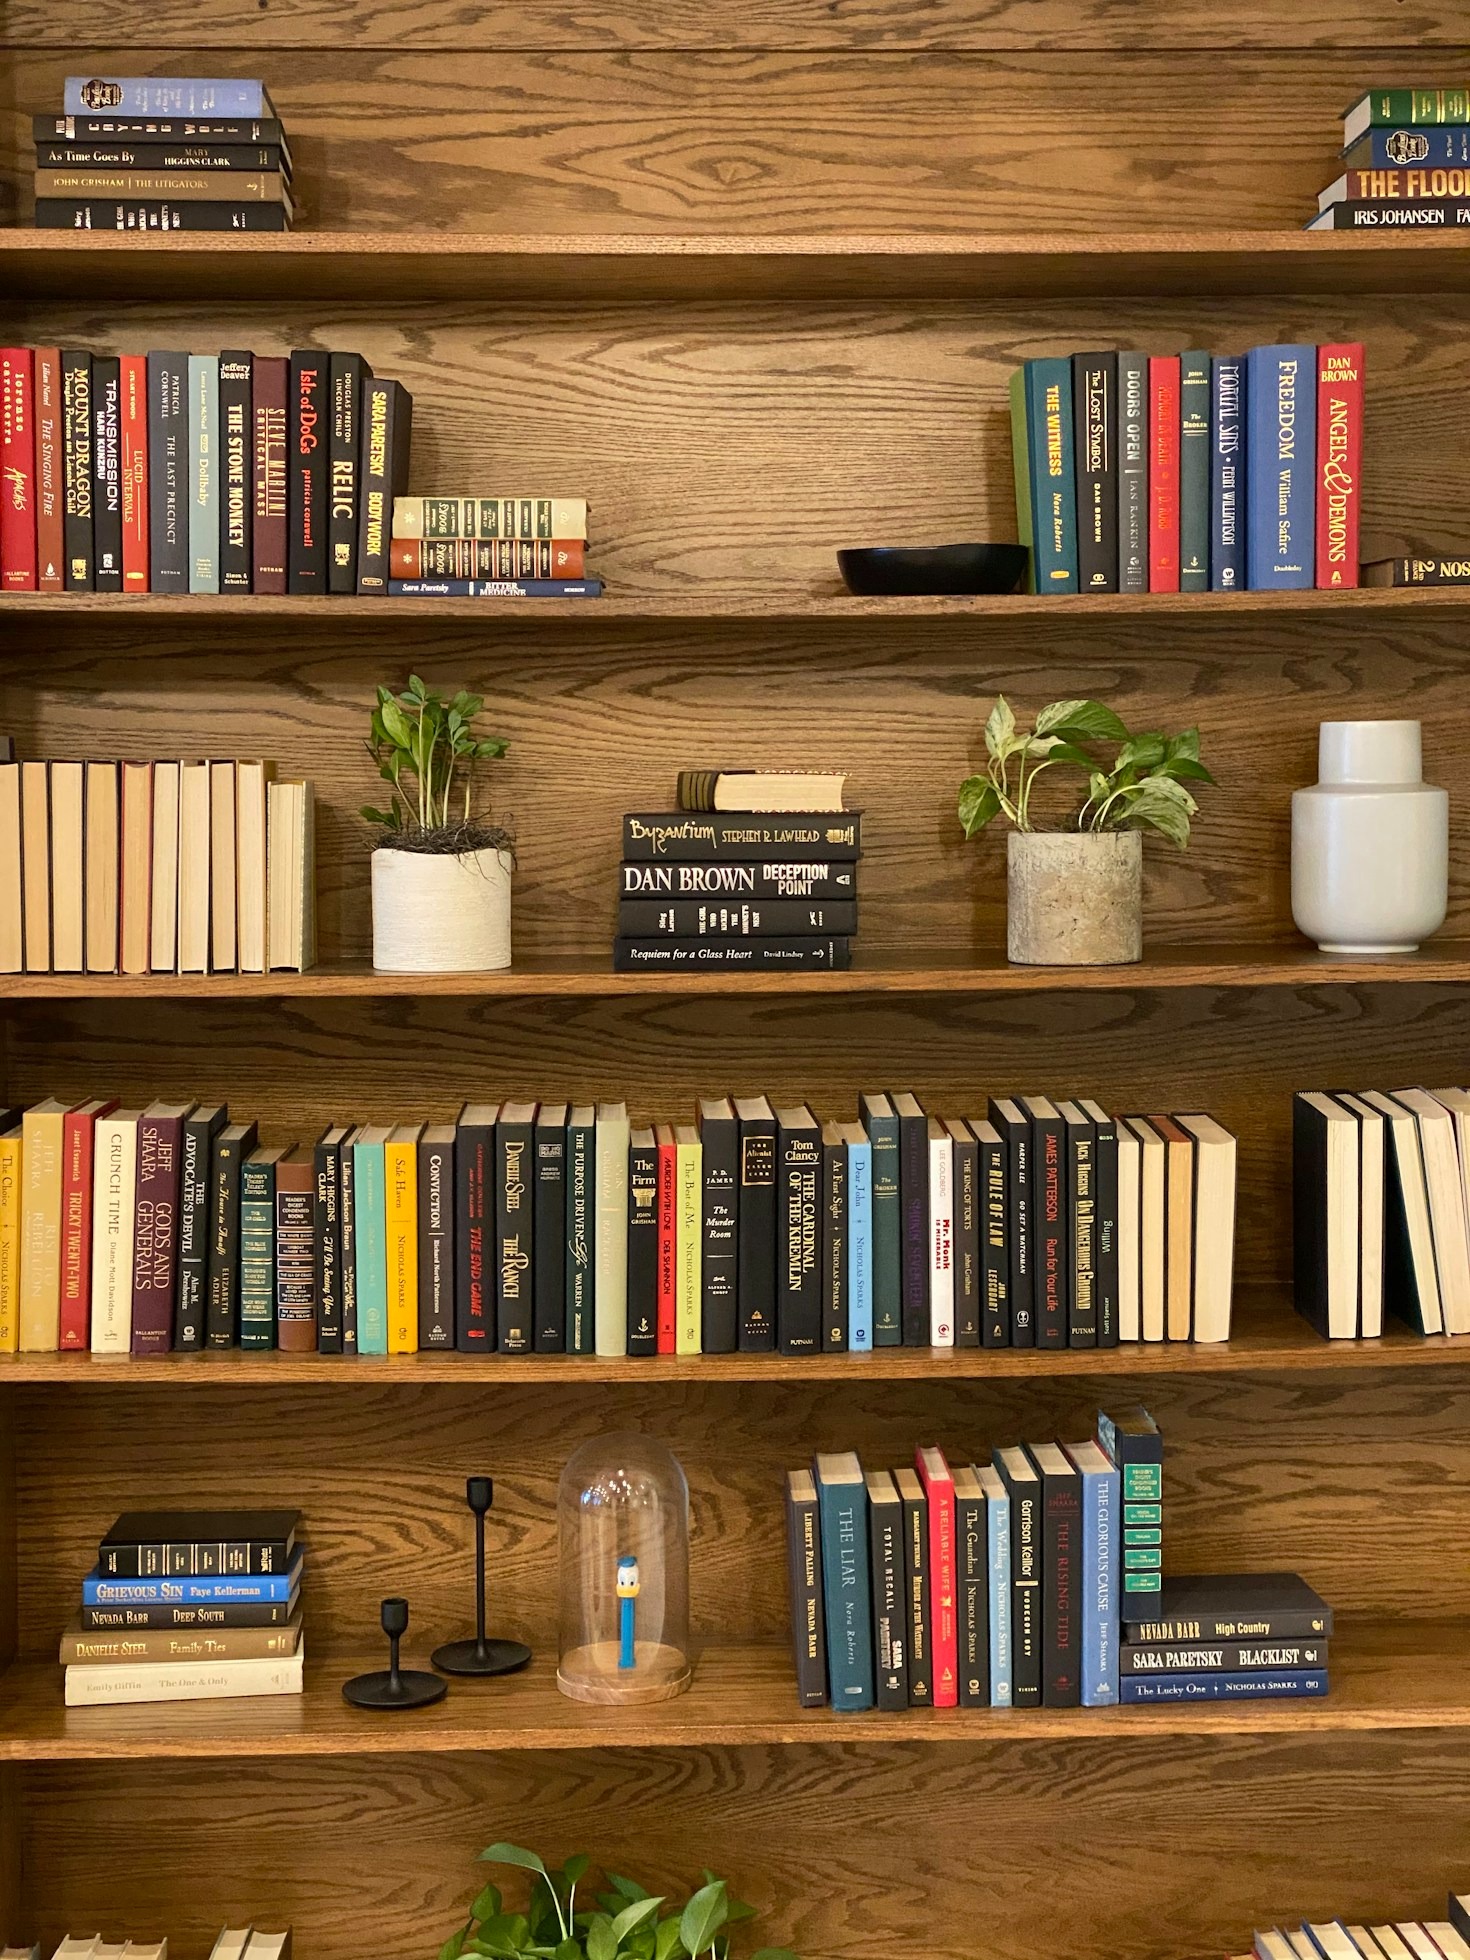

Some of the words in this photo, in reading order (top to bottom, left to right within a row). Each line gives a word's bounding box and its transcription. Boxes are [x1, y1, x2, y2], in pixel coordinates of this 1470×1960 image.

[49, 152, 62, 160] As
[65, 152, 90, 161] Time
[93, 152, 119, 162] Goes
[122, 152, 135, 163] By
[165, 158, 200, 166] HIGGINS
[201, 158, 230, 166] CLARK
[156, 180, 208, 188] LITIGATORS
[1357, 170, 1399, 198] THE
[1355, 211, 1378, 224] IRIS
[1380, 210, 1444, 224] JOHANSEN
[1321, 370, 1357, 382] BROWN
[1328, 357, 1350, 368] DAN
[300, 370, 317, 394] Isle
[1092, 371, 1100, 386] The
[1219, 366, 1239, 421] MORTAL
[74, 368, 89, 436] MOUNT
[161, 371, 169, 418] CORNWELL
[300, 397, 314, 410] of
[371, 392, 386, 420] SARA
[1047, 385, 1059, 411] THE
[1091, 389, 1103, 420] LOST
[1127, 371, 1140, 418] DOORS
[1279, 361, 1297, 459] FREEDOM
[42, 420, 53, 439] THE
[228, 405, 242, 432] THE
[269, 409, 286, 447] STEVE
[1330, 398, 1347, 462] ANGELS
[106, 380, 117, 510] TRANSMISSION
[167, 436, 175, 458] THE
[257, 408, 265, 470] CRITICAL
[369, 423, 385, 476] PARETSKY
[1047, 414, 1062, 476] WITNESS
[1091, 424, 1103, 472] SYMBOL
[1127, 424, 1140, 460] OPEN
[1219, 424, 1239, 453] SINS
[42, 443, 54, 488] SINGING
[133, 450, 143, 482] LUCID
[167, 462, 175, 487] LAST
[228, 438, 243, 482] STONE
[75, 441, 90, 518] DRAGON
[197, 459, 209, 506] Dollbaby
[269, 460, 286, 516] MARTINI
[333, 461, 353, 518] RELIC
[1279, 470, 1291, 515] William
[43, 492, 54, 516] FIRE
[124, 469, 133, 522] INTERVALS
[257, 481, 265, 516] MASS
[167, 492, 175, 544] PRECINCT
[229, 487, 243, 547] MONKEY
[1329, 495, 1347, 562] DEMONS
[1279, 521, 1290, 554] Safire
[630, 820, 717, 854] Byzantium
[722, 831, 760, 842] STEPHEN
[764, 831, 771, 842] R.
[774, 831, 819, 842] LAWHEAD
[625, 868, 672, 890] DAN
[679, 868, 755, 890] BROWN
[763, 865, 828, 880] DECEPTION
[778, 880, 813, 895] POINT
[631, 950, 670, 960] Requiem
[673, 950, 687, 959] for
[699, 949, 723, 958] Glass
[726, 950, 752, 958] Heart
[142, 1127, 156, 1182] SHAARA
[158, 1139, 172, 1171] JEFF
[576, 1133, 584, 1149] THE
[785, 1151, 819, 1161] Clancy
[791, 1140, 813, 1150] Tom
[1046, 1134, 1057, 1164] JAMES
[110, 1134, 122, 1193] CRUNCH
[185, 1133, 196, 1212] ADVOCATE'S
[395, 1159, 405, 1176] Safe
[505, 1141, 524, 1181] DANIELLE
[575, 1153, 584, 1196] PURPOSE
[855, 1161, 865, 1182] Dear
[991, 1153, 1000, 1166] THE
[195, 1182, 205, 1204] THE
[396, 1181, 406, 1208] Haven
[430, 1155, 442, 1228] CONVICTION
[789, 1172, 801, 1189] OF
[803, 1172, 815, 1200] THE
[989, 1170, 1003, 1199] RULE
[1046, 1168, 1057, 1221] PATTERSON
[69, 1192, 82, 1227] TRICKY
[327, 1186, 335, 1222] HIGGINS
[505, 1182, 525, 1212] STEEL
[789, 1194, 801, 1226] THE
[855, 1186, 865, 1207] John
[989, 1203, 1003, 1218] OF
[108, 1200, 120, 1234] TIME
[155, 1203, 171, 1247] GODS
[575, 1200, 585, 1237] DRIVEN
[136, 1200, 153, 1290] GENERALS
[182, 1215, 194, 1253] DEVIL
[470, 1227, 481, 1251] THE
[503, 1233, 518, 1253] THE
[802, 1204, 815, 1273] CARDINAL
[990, 1222, 1003, 1246] LAW
[1047, 1239, 1057, 1256] Run
[1101, 1220, 1113, 1253] Willing
[66, 1230, 82, 1298] TWENTY-TWO
[471, 1254, 481, 1279] END
[568, 1238, 587, 1269] Life
[789, 1229, 801, 1291] KREMLIN
[942, 1240, 950, 1269] Monk
[1047, 1259, 1058, 1270] for
[153, 1251, 169, 1288] AND
[501, 1253, 529, 1298] RANCH
[1047, 1273, 1057, 1292] Your
[471, 1282, 482, 1316] GAME
[1047, 1295, 1057, 1311] Life
[1098, 1481, 1108, 1506] THE
[839, 1508, 853, 1543] THE
[1021, 1500, 1033, 1543] Garrison
[884, 1527, 892, 1562] TOTAL
[1097, 1509, 1108, 1570] GLORIOUS
[841, 1549, 855, 1587] LIAR
[1022, 1546, 1033, 1576] Keillor
[97, 1583, 156, 1599] GRIEVOUS
[161, 1583, 183, 1598] SIN
[885, 1569, 894, 1610] RECALL
[1098, 1574, 1108, 1611] CAUSE
[92, 1612, 123, 1625] NEVADA
[127, 1611, 148, 1624] BARR
[173, 1610, 195, 1622] DEEP
[198, 1609, 224, 1622] SOUTH
[1140, 1623, 1173, 1639] NEVADA
[1177, 1622, 1200, 1639] BARR
[1216, 1623, 1235, 1636] High
[1237, 1622, 1270, 1635] Country
[892, 1641, 902, 1669] SARA
[1134, 1653, 1163, 1669] SARA
[1166, 1651, 1223, 1668] PARETSKY
[1240, 1649, 1299, 1665] BLACKLIST
[1136, 1685, 1155, 1695] The
[1157, 1683, 1183, 1697] Lucky
[1187, 1683, 1205, 1694] One
